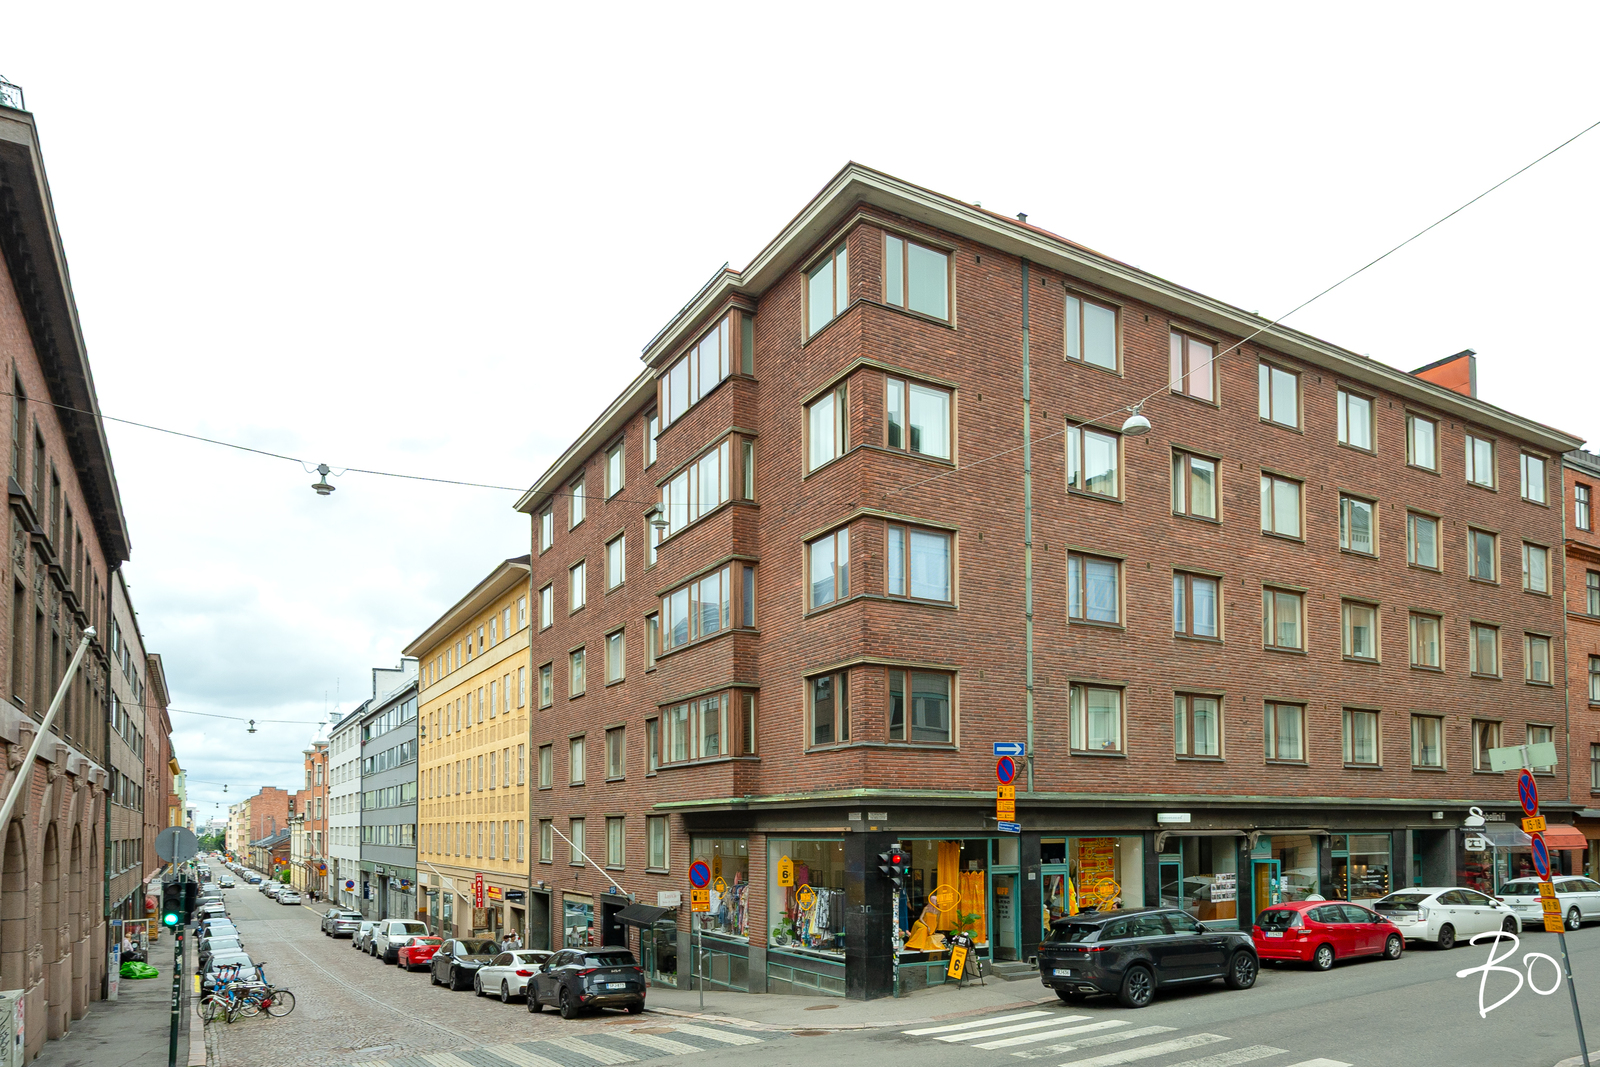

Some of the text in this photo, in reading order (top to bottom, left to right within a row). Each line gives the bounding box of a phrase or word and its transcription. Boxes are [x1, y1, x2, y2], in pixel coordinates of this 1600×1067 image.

[1526, 818, 1542, 830] 15-18
[782, 870, 789, 879] 6
[996, 887, 1008, 895] UFF
[954, 959, 961, 971] 6
